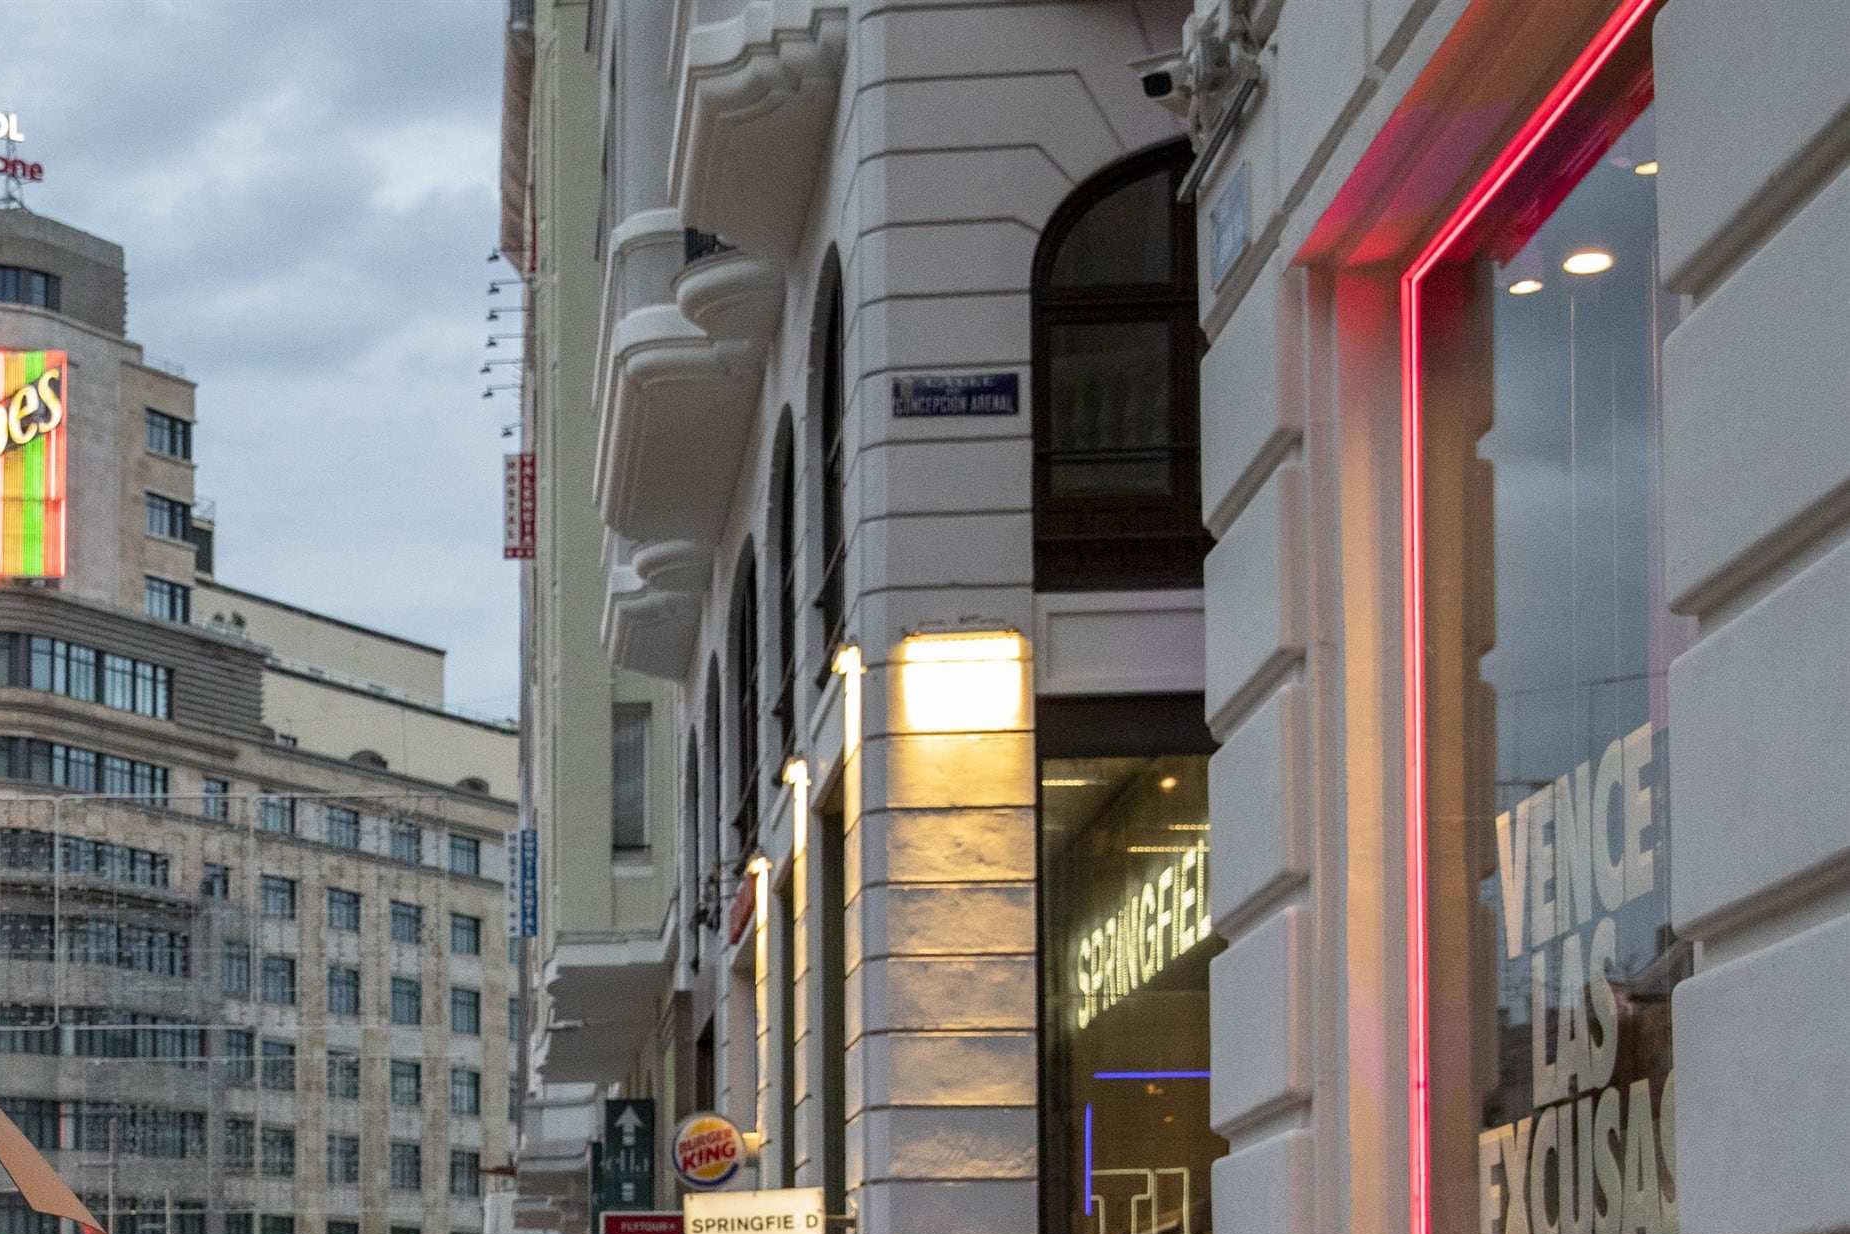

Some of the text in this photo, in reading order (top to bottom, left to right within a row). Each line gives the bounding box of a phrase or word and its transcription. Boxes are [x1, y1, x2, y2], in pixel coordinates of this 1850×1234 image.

[1495, 720, 1654, 959] VENCE
[1532, 916, 1617, 1107] LAS
[678, 1128, 733, 1156] BURGER
[681, 1143, 736, 1174] KING
